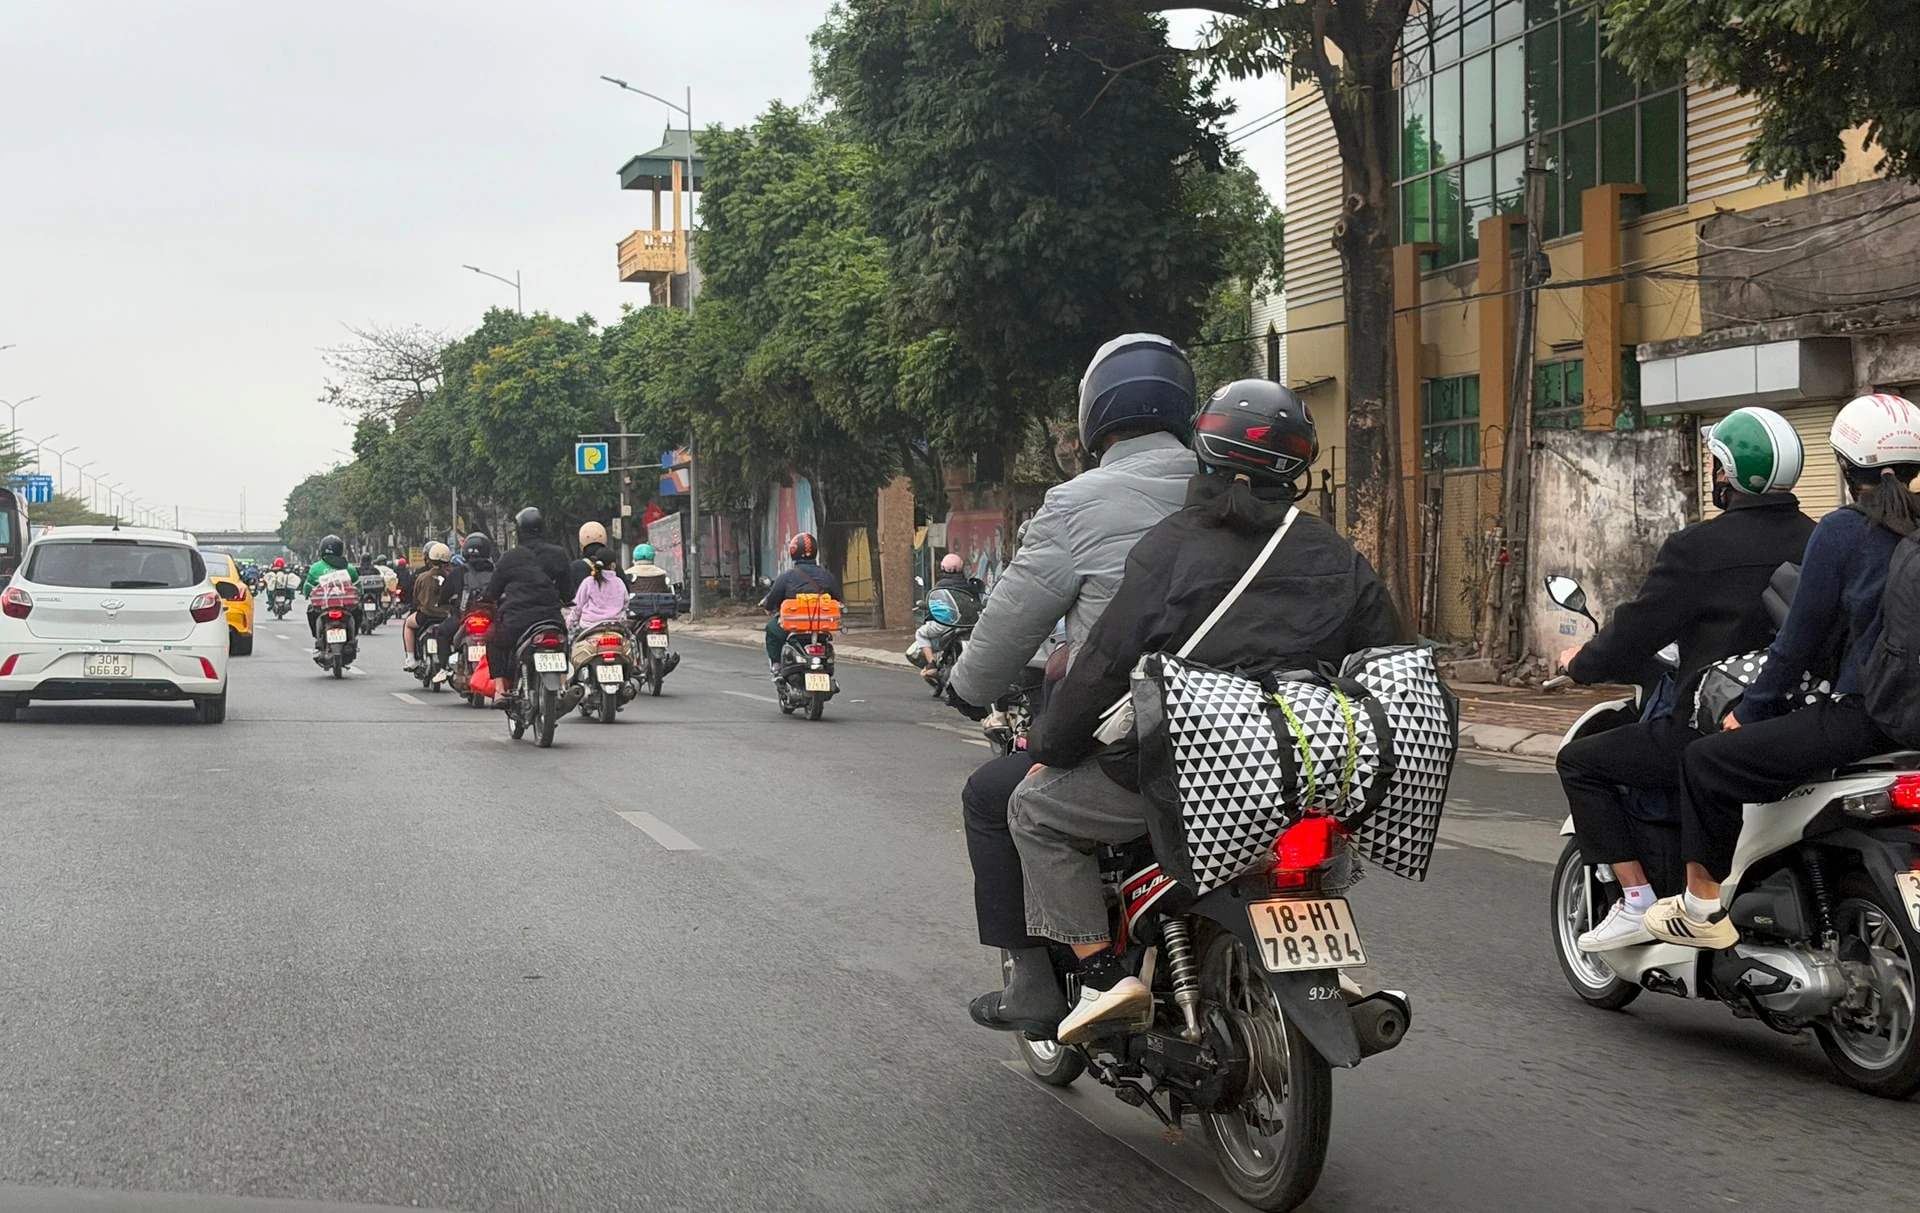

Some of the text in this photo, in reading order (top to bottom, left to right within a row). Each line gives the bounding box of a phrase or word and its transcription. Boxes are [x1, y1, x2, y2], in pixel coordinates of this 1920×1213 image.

[89, 665, 128, 676] 066.82
[98, 655, 120, 665] 30M
[1266, 902, 1340, 934] 18-H1
[1264, 932, 1361, 968] 783.84
